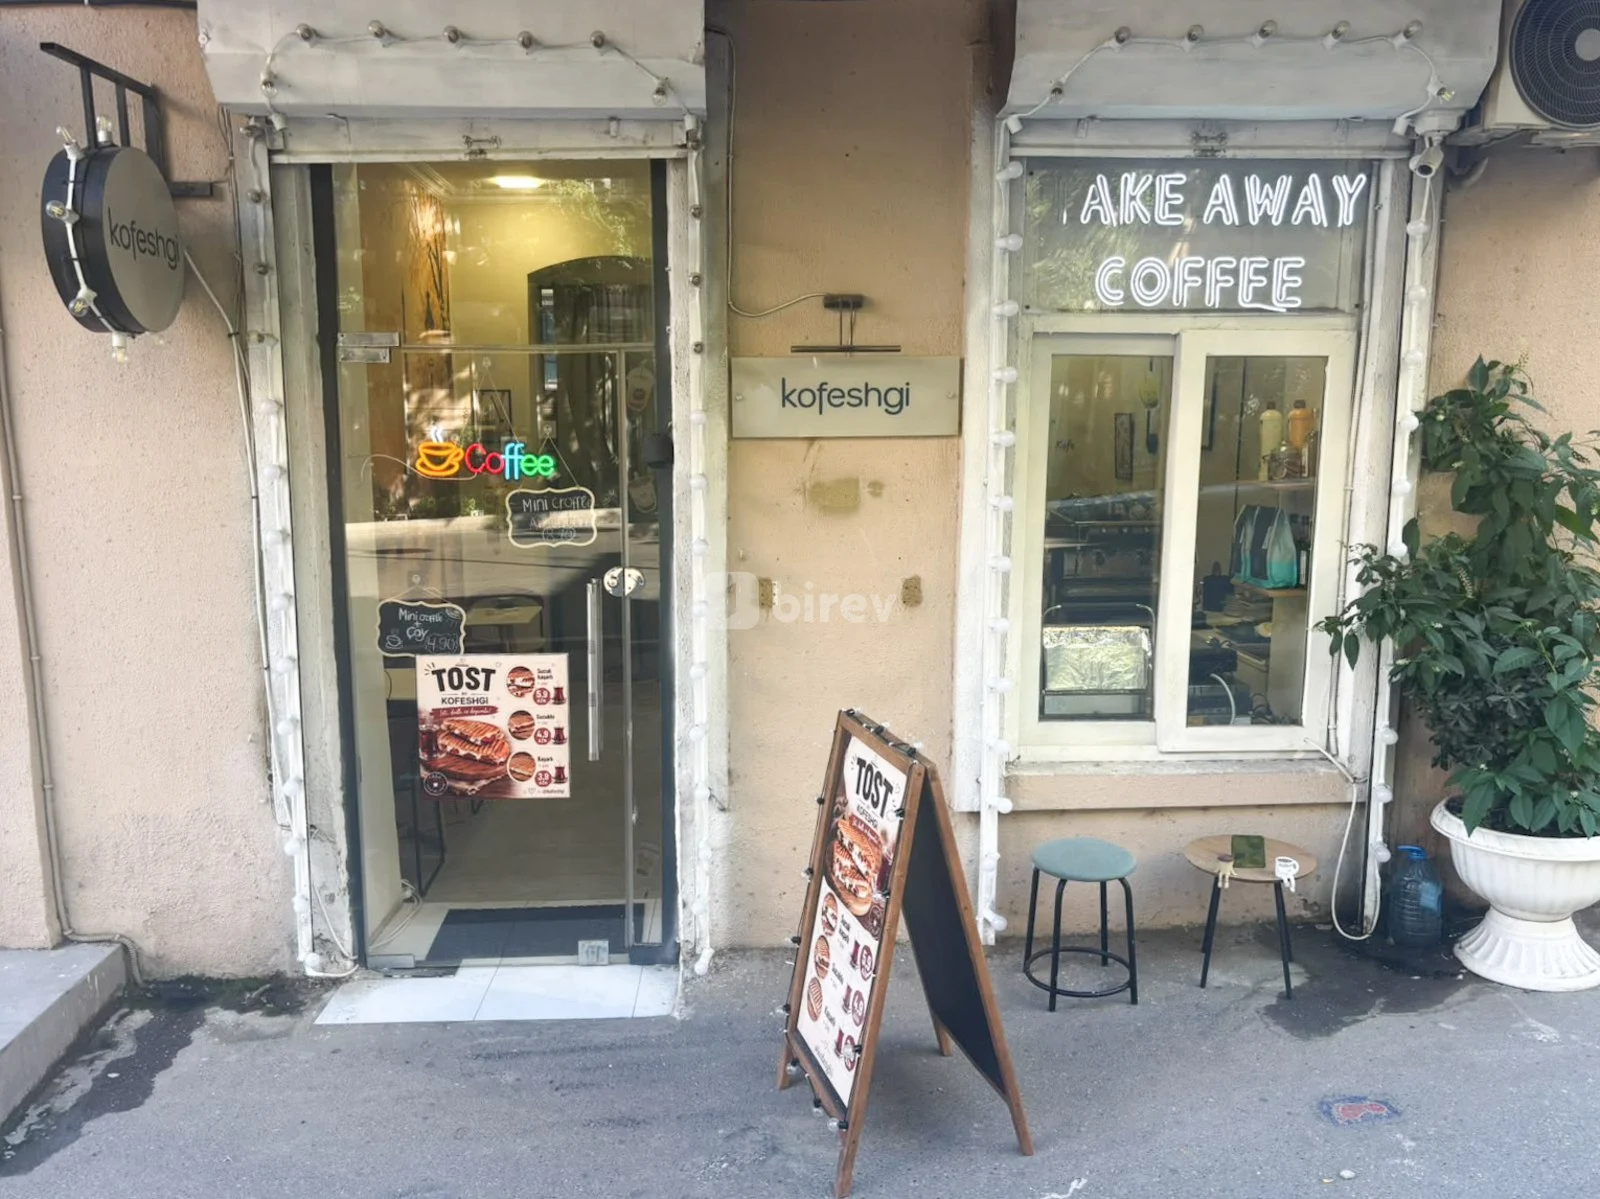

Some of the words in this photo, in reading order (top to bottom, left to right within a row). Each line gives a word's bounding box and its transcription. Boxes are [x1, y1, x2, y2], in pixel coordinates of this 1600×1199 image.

[1062, 173, 1187, 227] AKE
[1203, 173, 1367, 228] AWAY
[107, 205, 180, 270] kofeshgi
[1094, 256, 1306, 312] COFFEE
[781, 376, 911, 416] kofeshgi
[464, 442, 555, 481] Coffee
[522, 497, 549, 513] Mini
[398, 607, 418, 622] Mini
[431, 666, 496, 692] TOST
[855, 757, 893, 818] TOST
